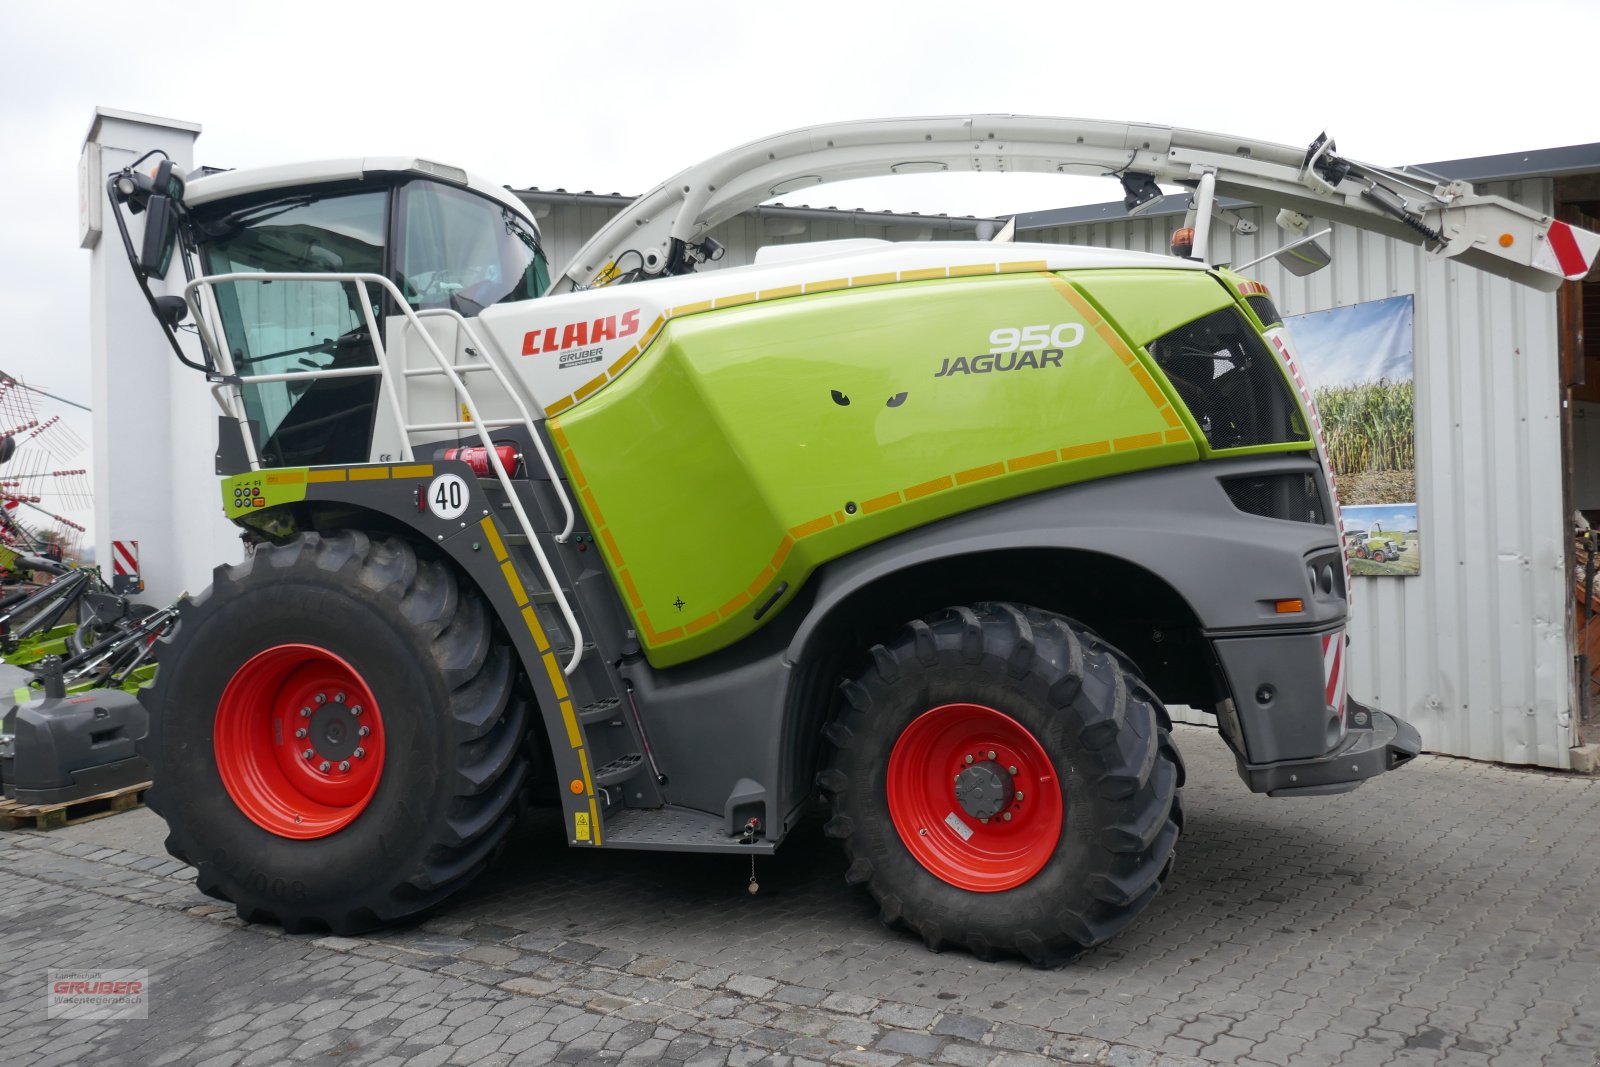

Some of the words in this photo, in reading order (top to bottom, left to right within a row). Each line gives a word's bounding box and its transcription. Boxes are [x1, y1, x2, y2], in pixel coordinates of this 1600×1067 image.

[522, 308, 640, 356] CLAAS
[989, 322, 1084, 354] 950
[559, 347, 603, 363] GRUBER
[934, 349, 1064, 377] JAGUAR
[435, 481, 461, 510] 40
